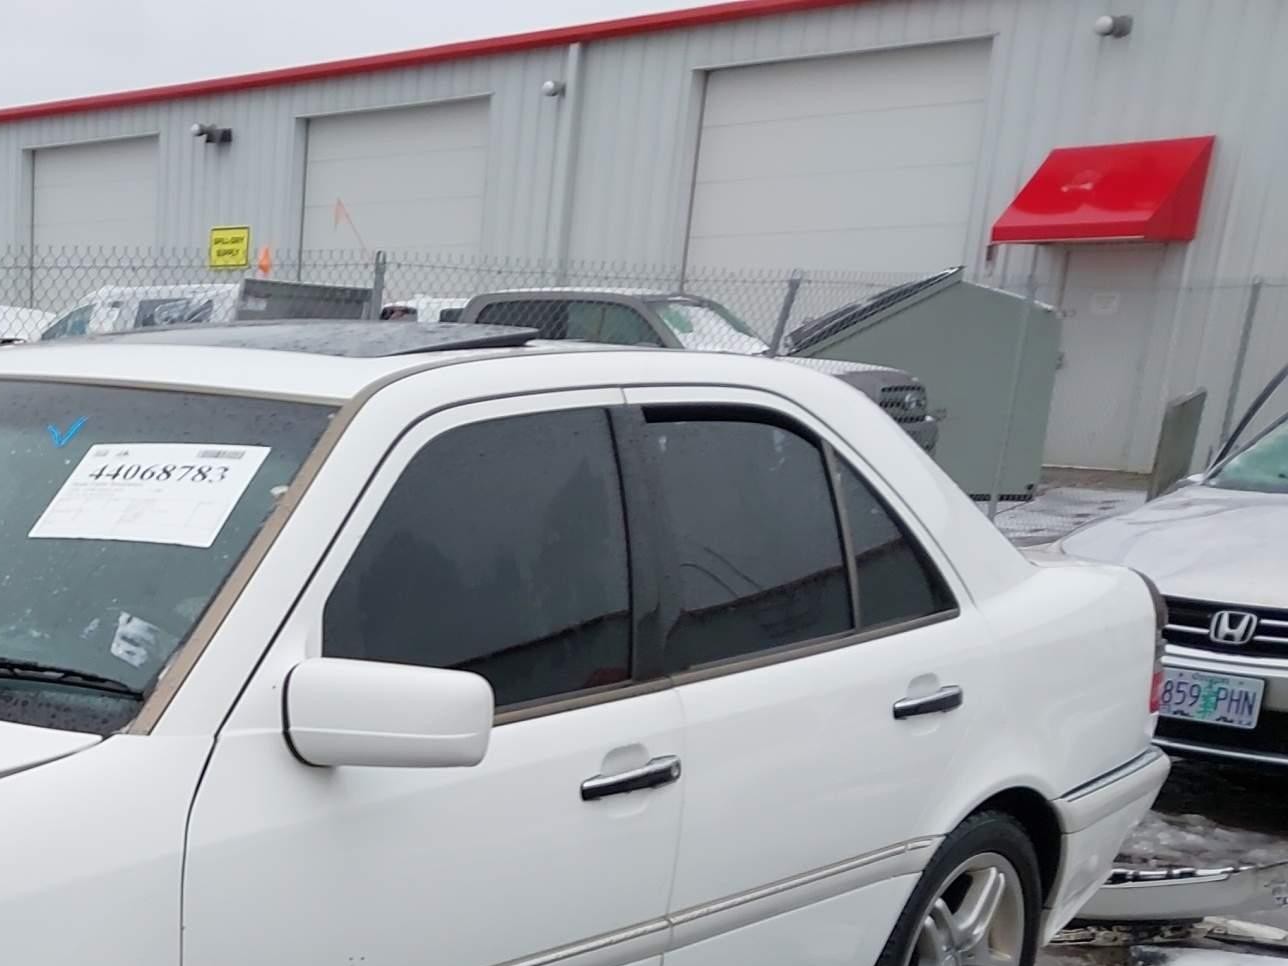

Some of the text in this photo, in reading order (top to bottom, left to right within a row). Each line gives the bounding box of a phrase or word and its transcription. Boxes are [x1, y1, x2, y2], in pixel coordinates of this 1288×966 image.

[89, 463, 229, 483] 44068783
[1161, 680, 1256, 716] 859 PHN
